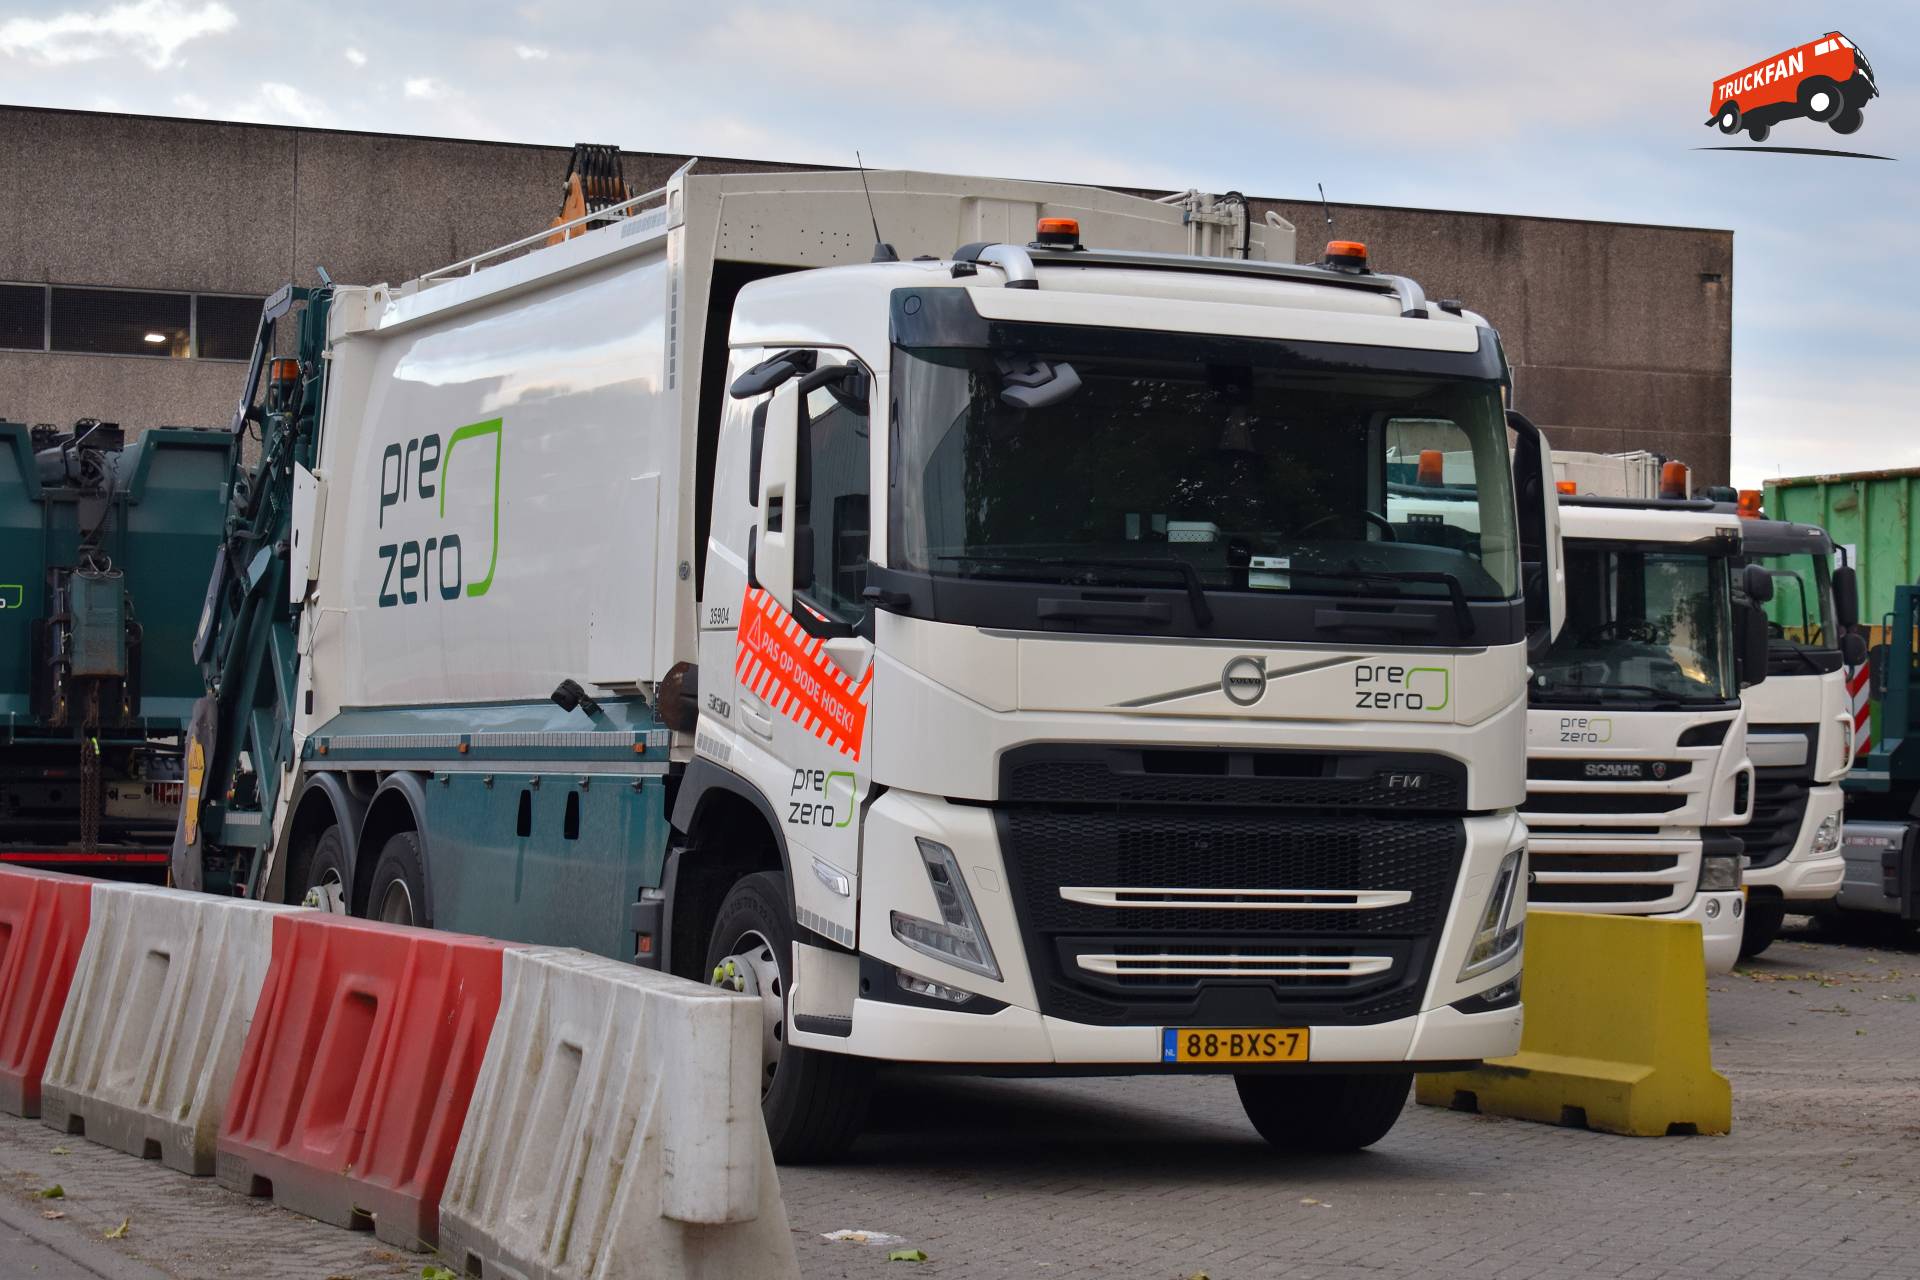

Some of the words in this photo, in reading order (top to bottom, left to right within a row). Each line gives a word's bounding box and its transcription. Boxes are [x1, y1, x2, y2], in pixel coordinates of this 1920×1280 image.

[379, 433, 441, 529] pre
[379, 534, 462, 607] zero
[709, 607, 730, 624] 35904
[762, 632, 780, 662] PAS
[780, 650, 793, 673] OP
[793, 665, 821, 702] DODE
[821, 689, 855, 733] HOEK!
[1229, 677, 1261, 685] VOLVO
[1355, 665, 1404, 687] pre
[708, 694, 730, 718] 330
[1355, 691, 1423, 710] zero
[1560, 718, 1588, 730] pre
[1560, 732, 1598, 742] zero
[1584, 764, 1642, 776] SCANIA
[791, 768, 825, 796] pre
[1388, 775, 1422, 788] FM
[788, 802, 834, 827] zero
[1165, 1048, 1176, 1057] NL
[1187, 1033, 1299, 1057] 88-BXS-7
